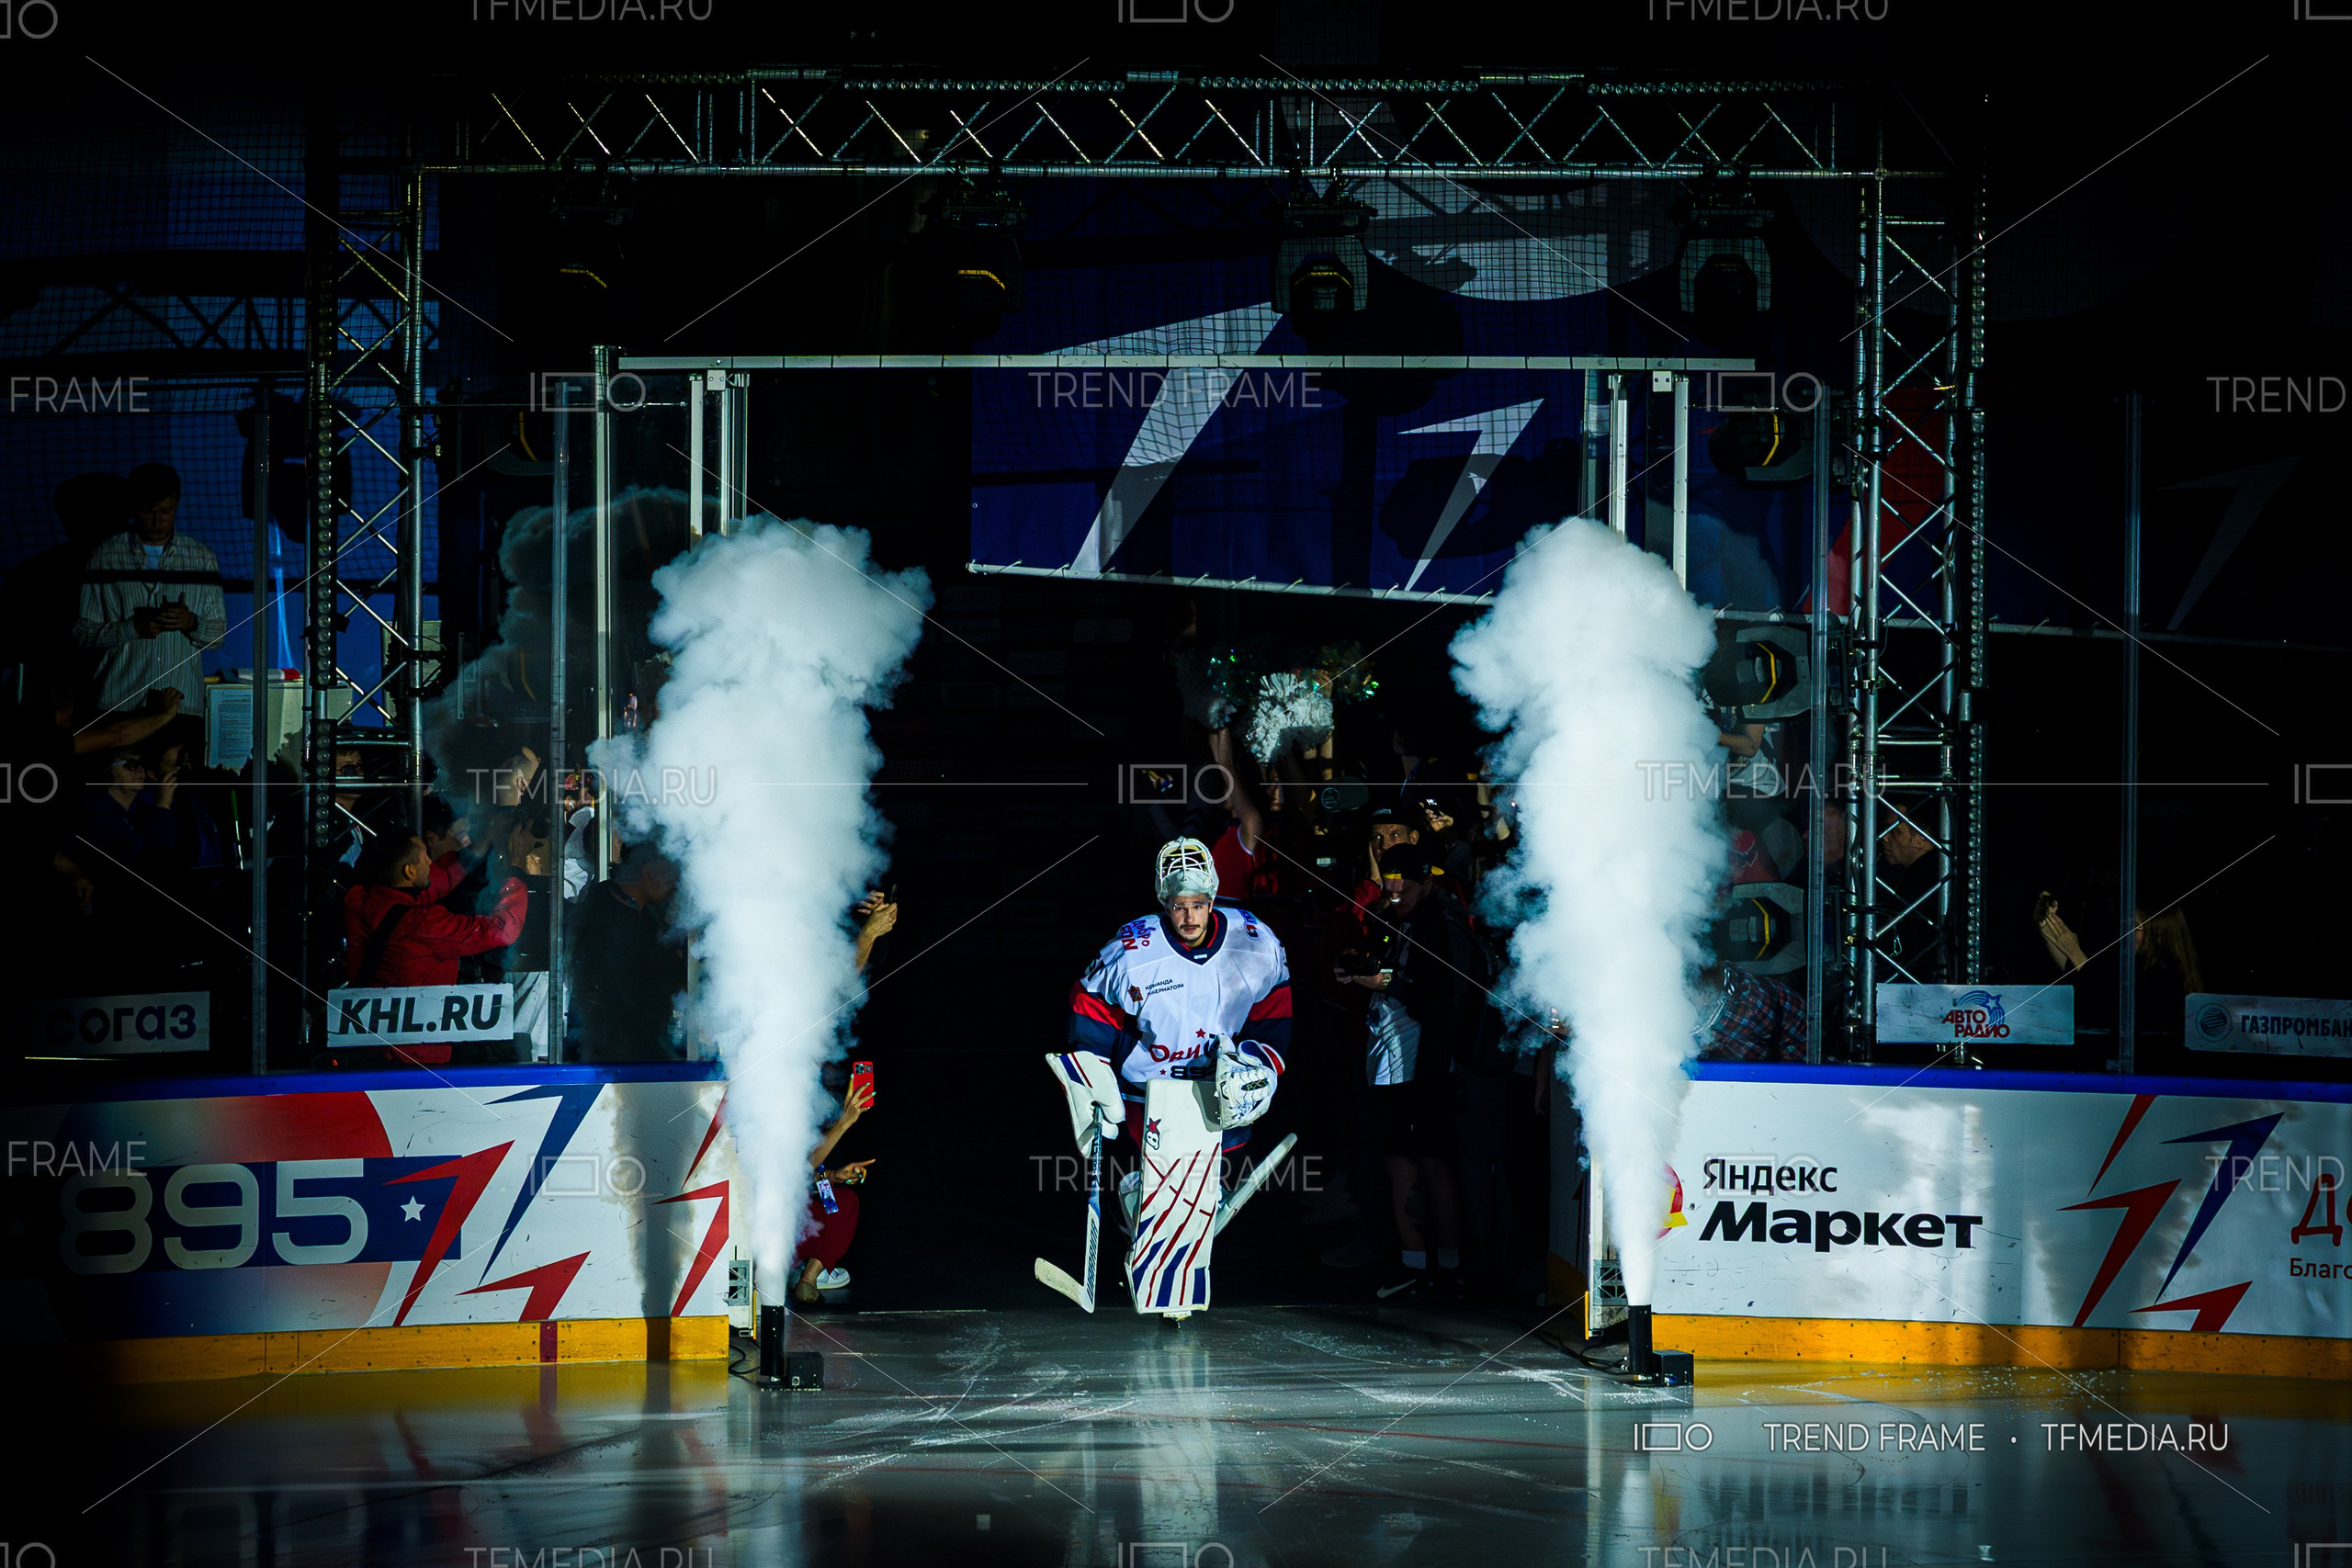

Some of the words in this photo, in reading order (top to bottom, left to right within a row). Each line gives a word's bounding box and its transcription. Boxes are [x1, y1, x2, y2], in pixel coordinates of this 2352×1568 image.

[339, 993, 503, 1034] KHL.RU
[1940, 1009, 1987, 1024] АВТО
[1954, 1023, 2010, 1038] РАДИО
[1703, 1158, 1838, 1195] Яндекс
[59, 1156, 369, 1276] 895
[1699, 1201, 1983, 1253] Маркет
[2290, 1173, 2352, 1247] Д
